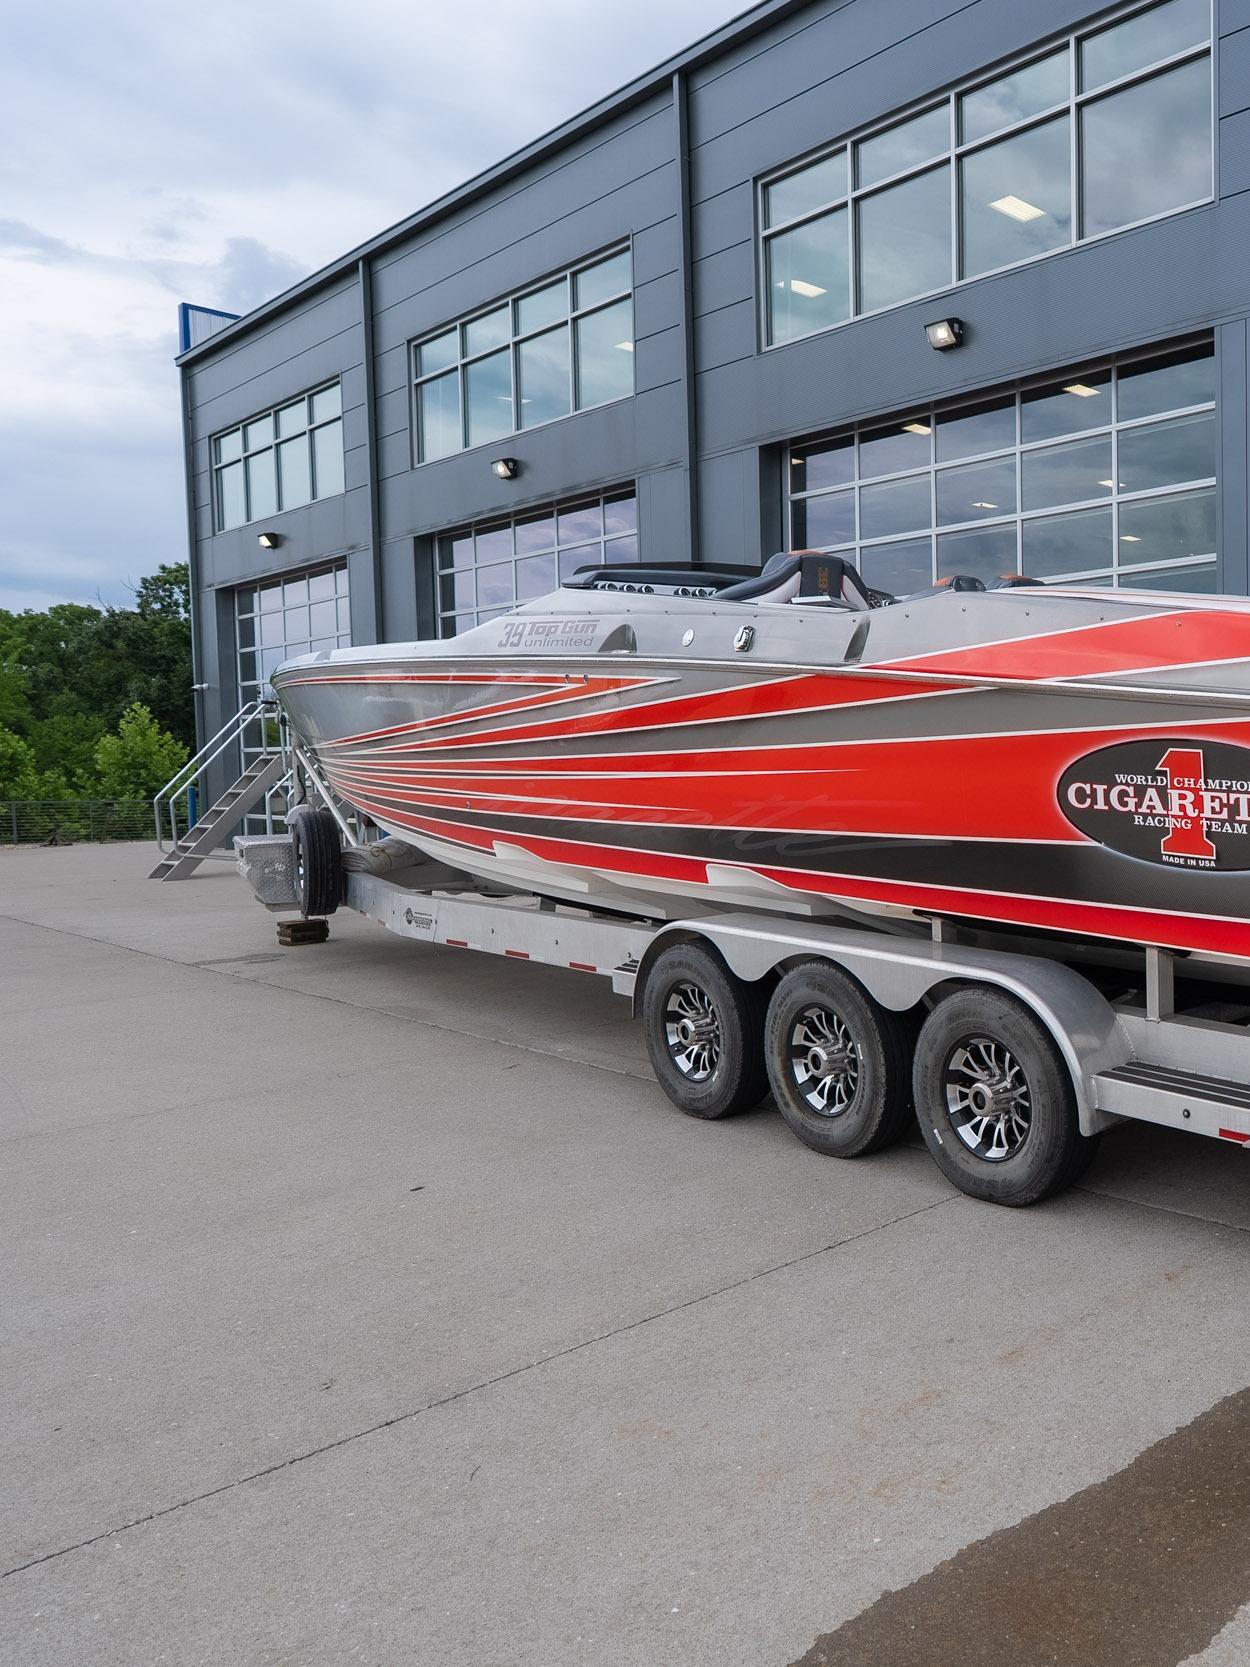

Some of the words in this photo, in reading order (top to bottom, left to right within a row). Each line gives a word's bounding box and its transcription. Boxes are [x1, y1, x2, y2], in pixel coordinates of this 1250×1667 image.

[498, 622, 528, 648] 39
[528, 621, 563, 637] Top
[561, 619, 600, 634] Gun
[524, 637, 594, 648] unlimited
[1115, 773, 1167, 787] WORLD
[1155, 748, 1217, 859] 1
[1133, 815, 1193, 830] RACING
[1200, 820, 1249, 835] TEAM
[1162, 855, 1185, 865] MADE
[1187, 858, 1196, 866] IN
[1198, 858, 1217, 867] USA
